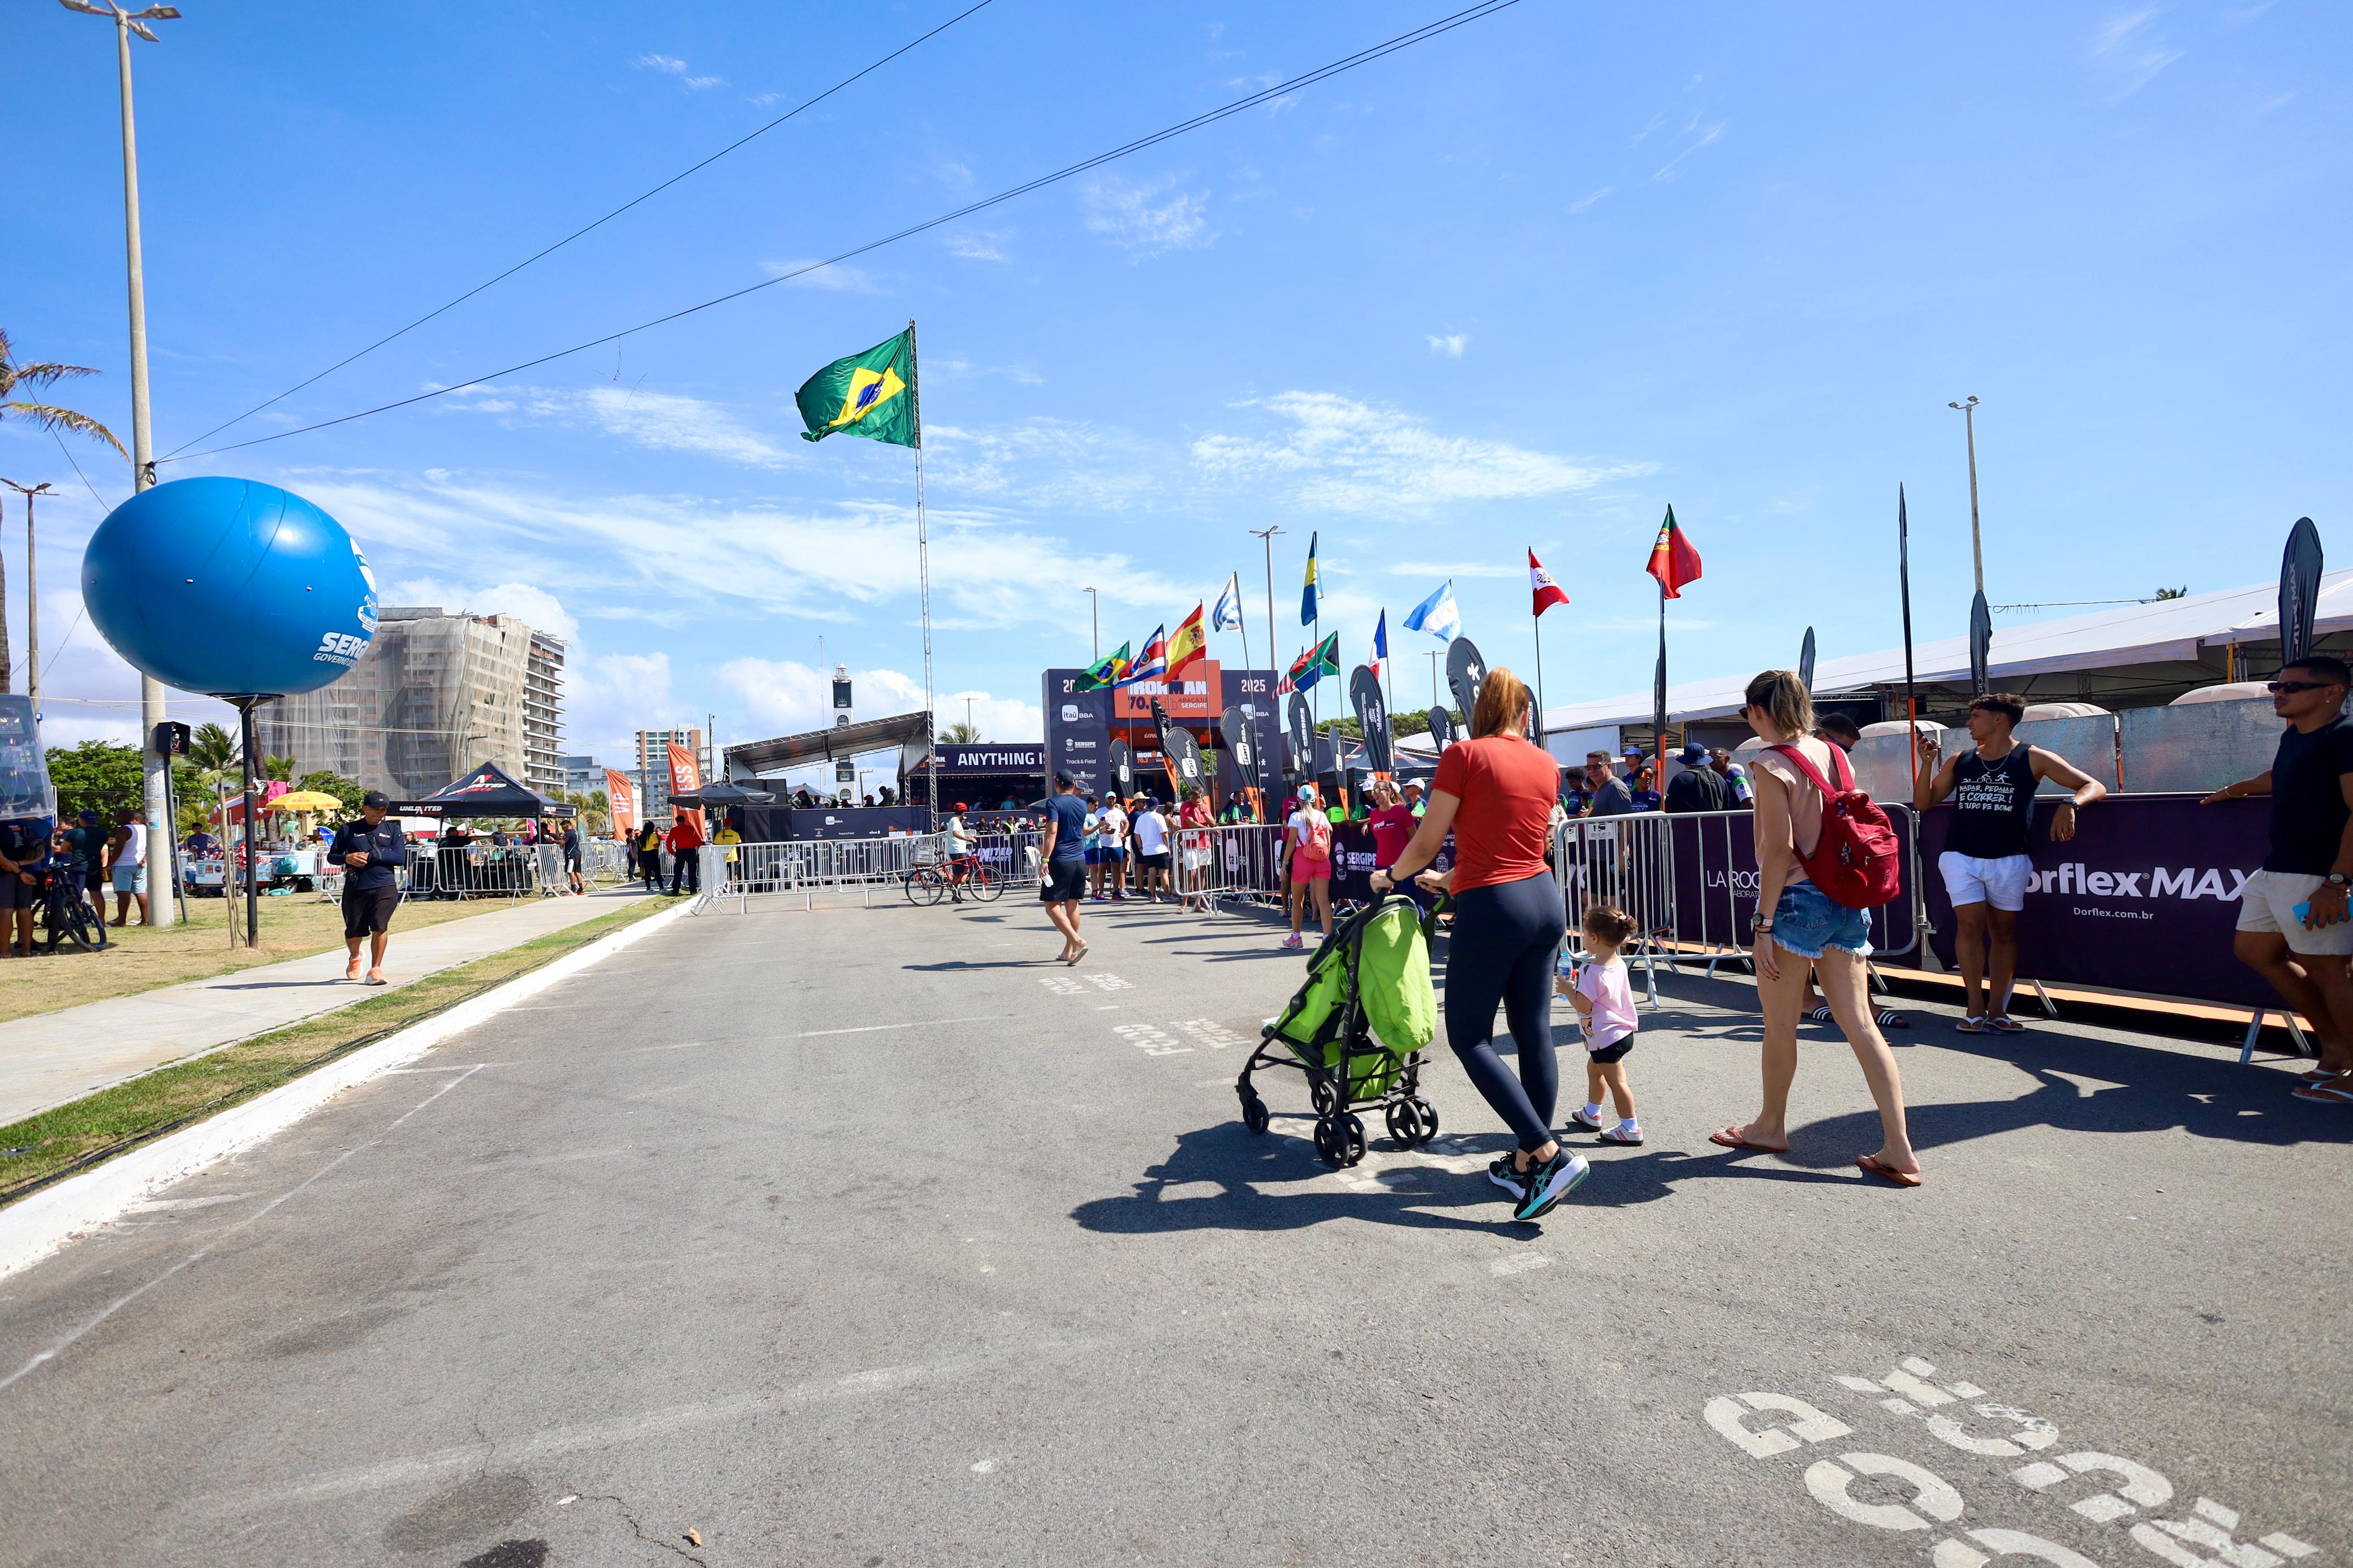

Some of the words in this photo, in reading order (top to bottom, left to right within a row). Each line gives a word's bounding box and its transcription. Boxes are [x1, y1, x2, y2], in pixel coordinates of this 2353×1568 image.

[1241, 679, 1266, 693] 2025
[1129, 696, 1157, 710] 70.
[958, 752, 1035, 766] ANYTHING
[1985, 785, 2015, 794] PEDALAR
[613, 792, 630, 814] VIP
[1959, 793, 1966, 801] E
[1967, 792, 2006, 802] CORRER
[1707, 870, 1727, 888] LA
[1728, 870, 1760, 889] ROC
[2149, 866, 2253, 902] MAX
[2073, 906, 2154, 919] Dorflex.com.br
[1833, 1356, 2321, 1568] RUCK
